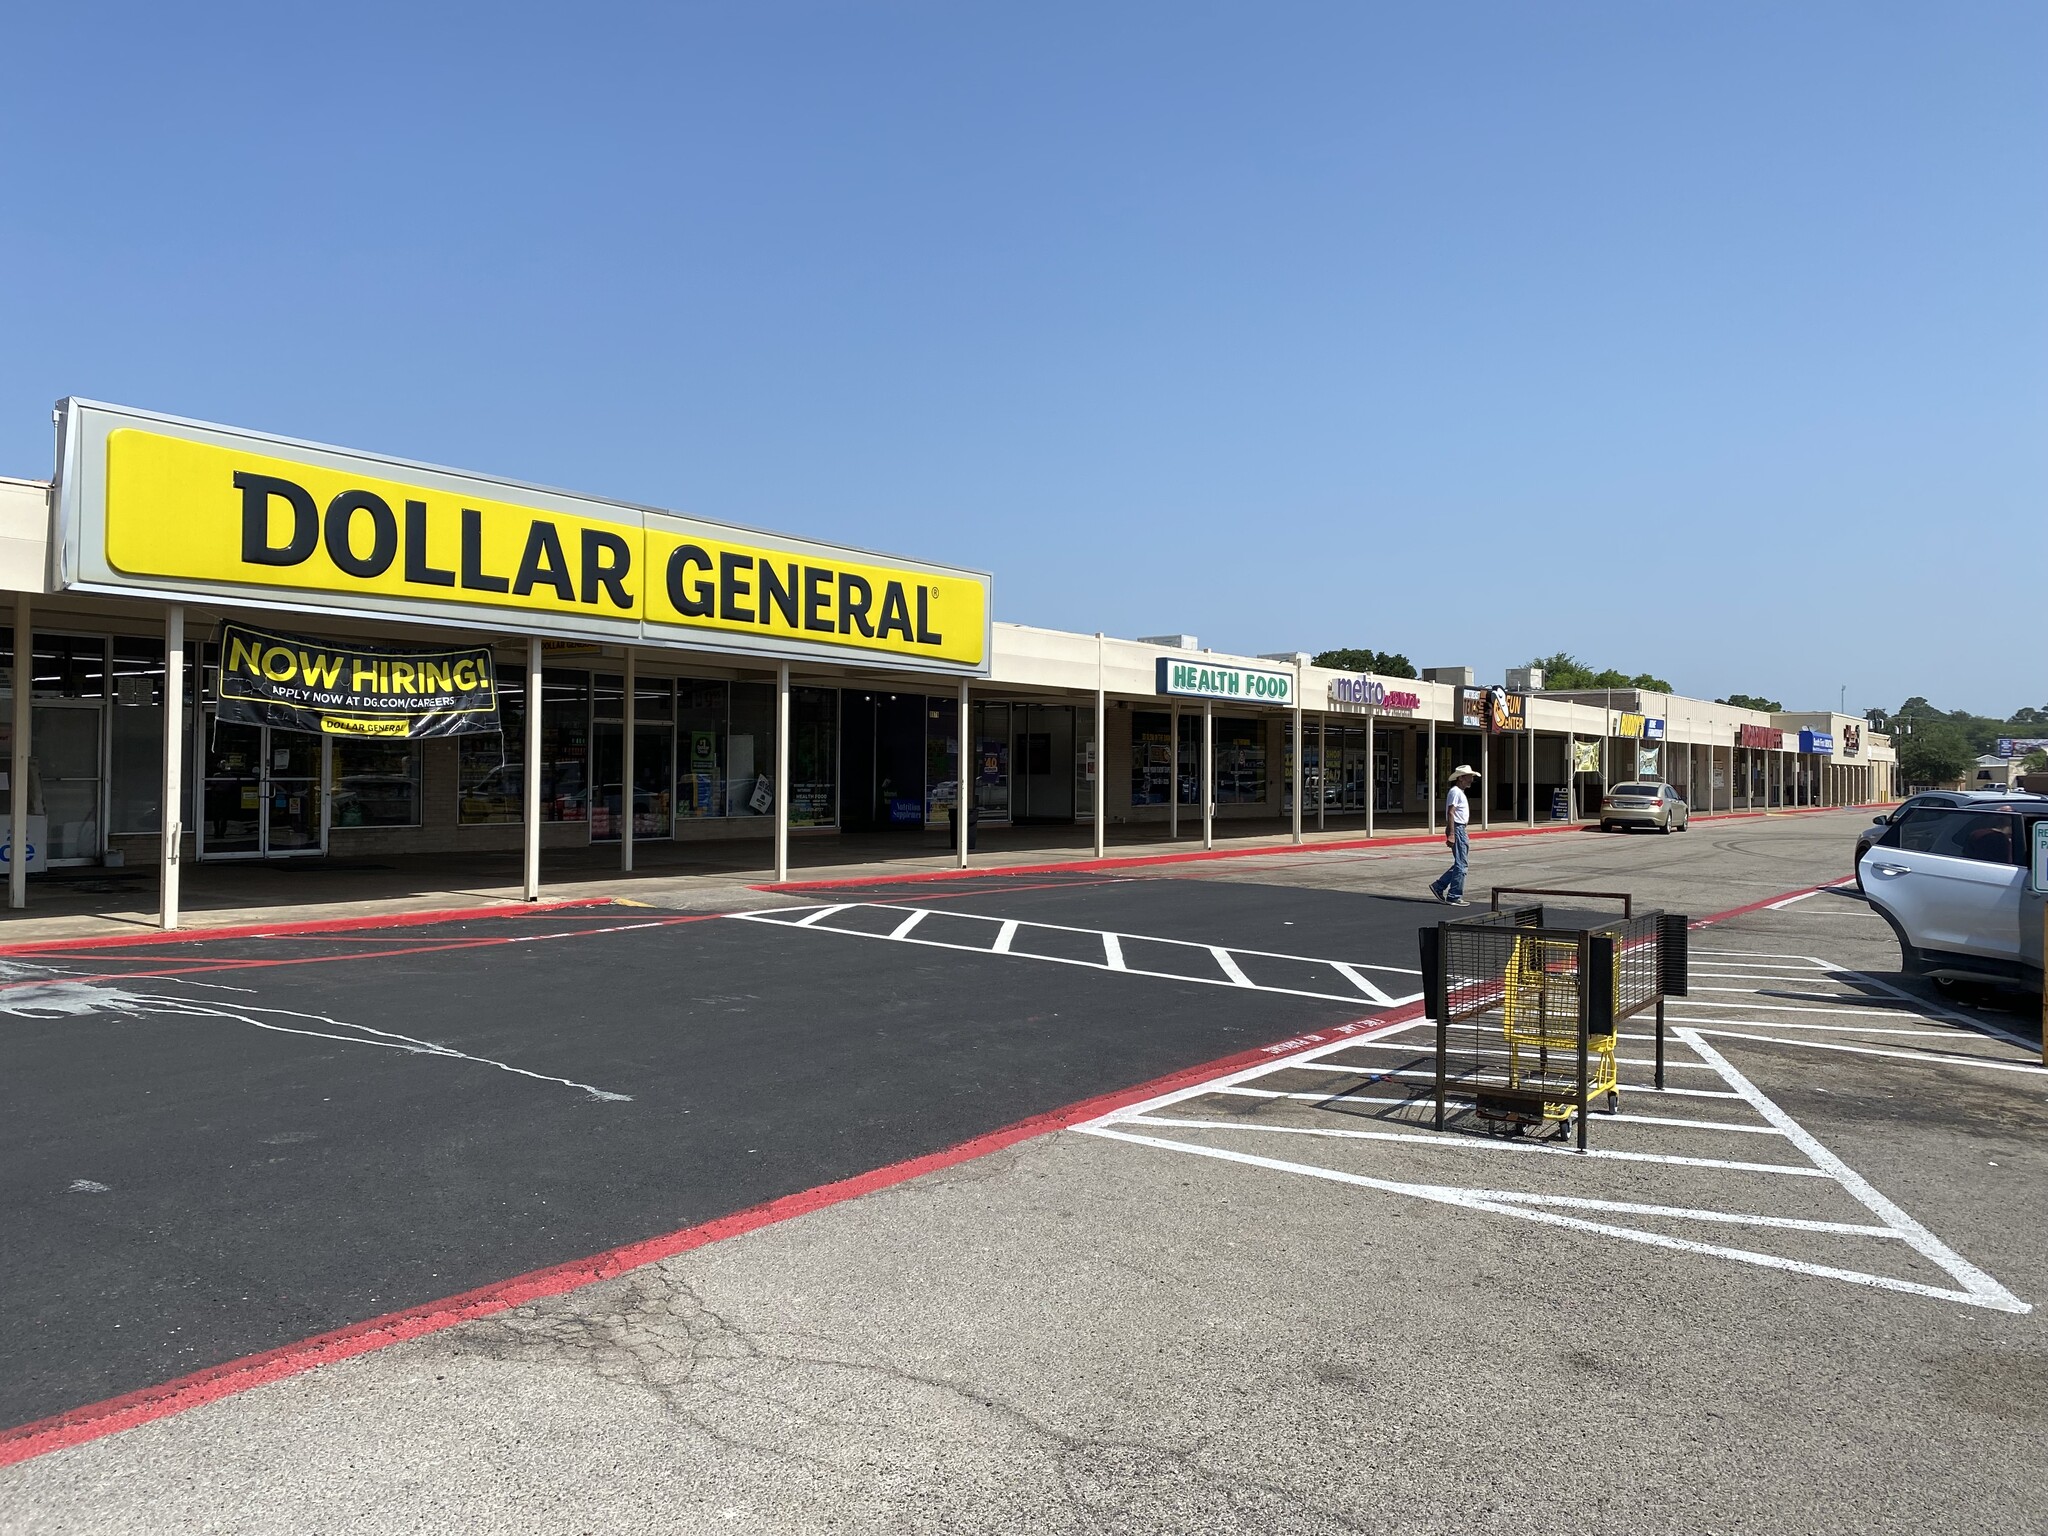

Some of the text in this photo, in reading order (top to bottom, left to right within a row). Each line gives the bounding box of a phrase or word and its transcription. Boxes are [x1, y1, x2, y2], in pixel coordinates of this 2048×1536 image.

[233, 470, 942, 645] DOLLAR GENERAL
[228, 637, 489, 694] NOW HIRING!
[1173, 665, 1288, 699] HEALTH FOOD
[1334, 675, 1384, 705] metro
[272, 685, 455, 708] APPLY NOW AT DG.COM/CAREERS
[1506, 695, 1522, 714] FUN
[326, 720, 406, 733] DOLLAR GENERAL
[1503, 717, 1524, 730] ENTER
